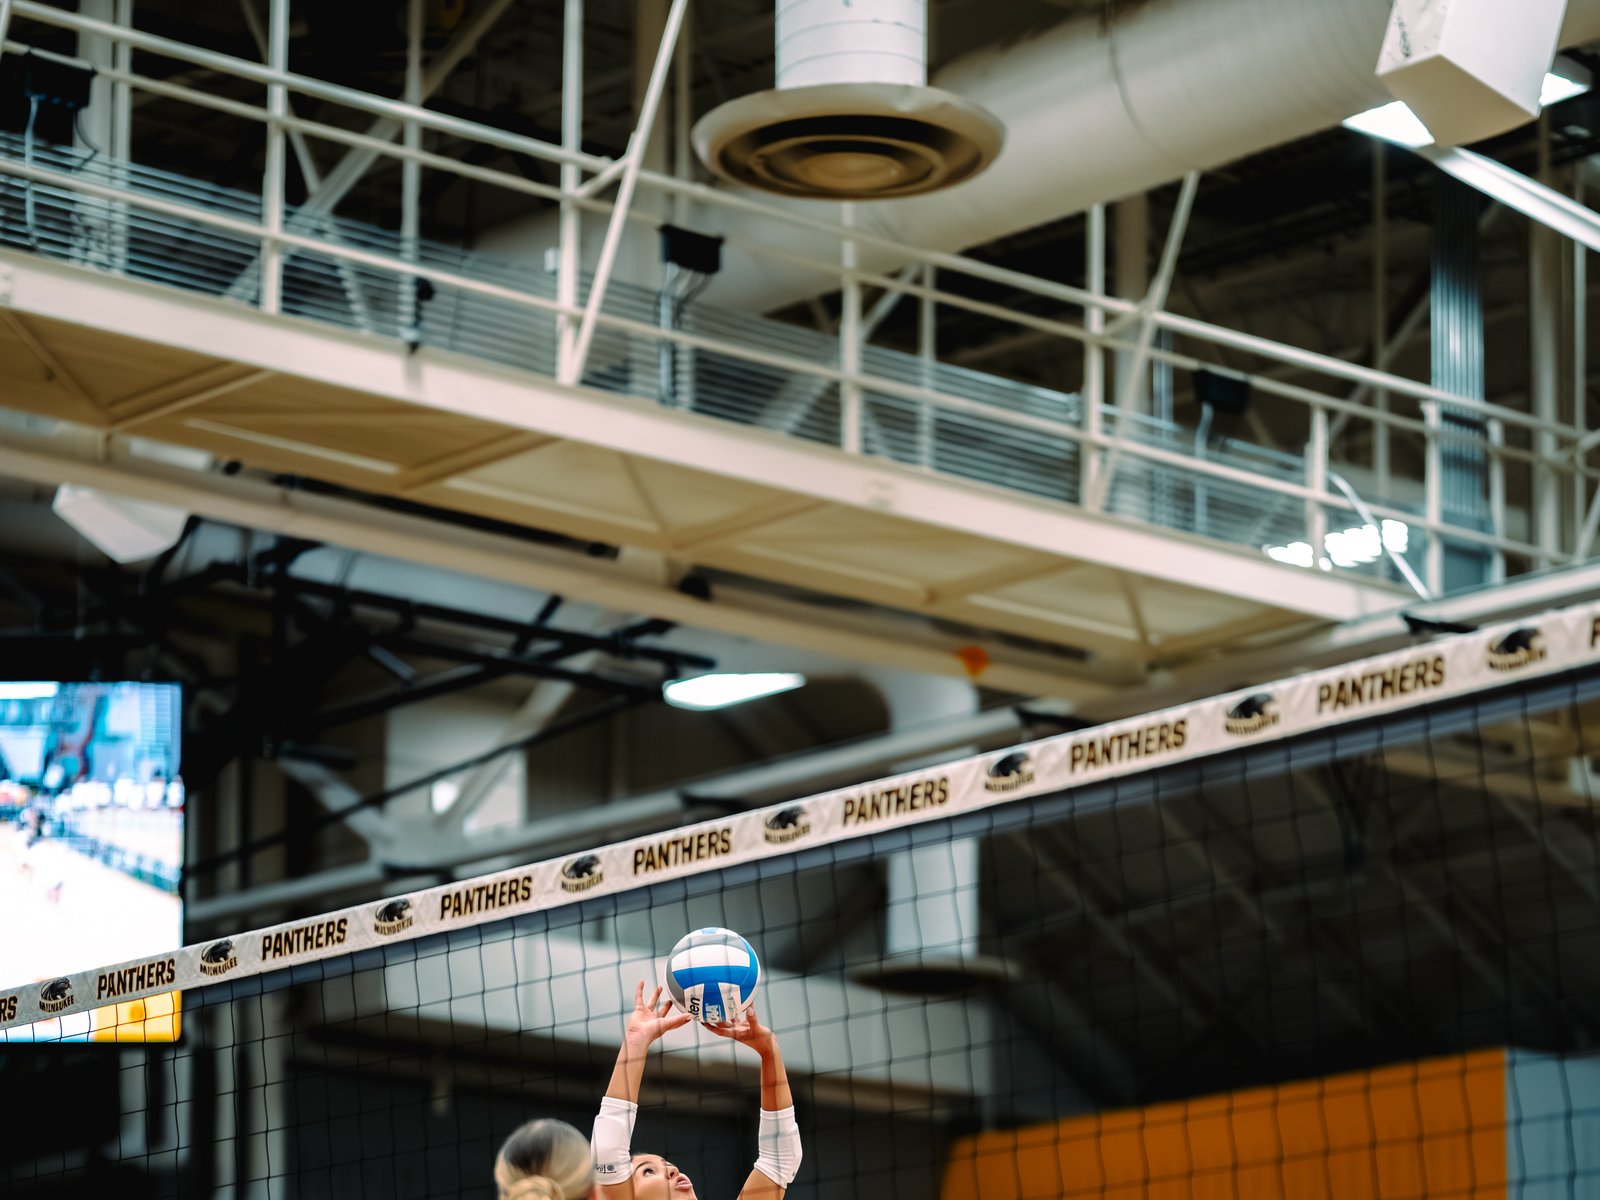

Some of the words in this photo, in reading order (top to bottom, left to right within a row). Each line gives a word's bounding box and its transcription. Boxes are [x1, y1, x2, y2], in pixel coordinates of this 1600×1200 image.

[1317, 656, 1445, 713] PANTHERS
[1070, 719, 1187, 773] PANTHERS
[843, 777, 950, 826] PANTHERS
[633, 828, 732, 875] PANTHERS
[440, 876, 532, 920] PANTHERS
[262, 918, 348, 961] PANTHERS
[97, 958, 176, 1000] PANTHERS
[688, 996, 701, 1018] ten
